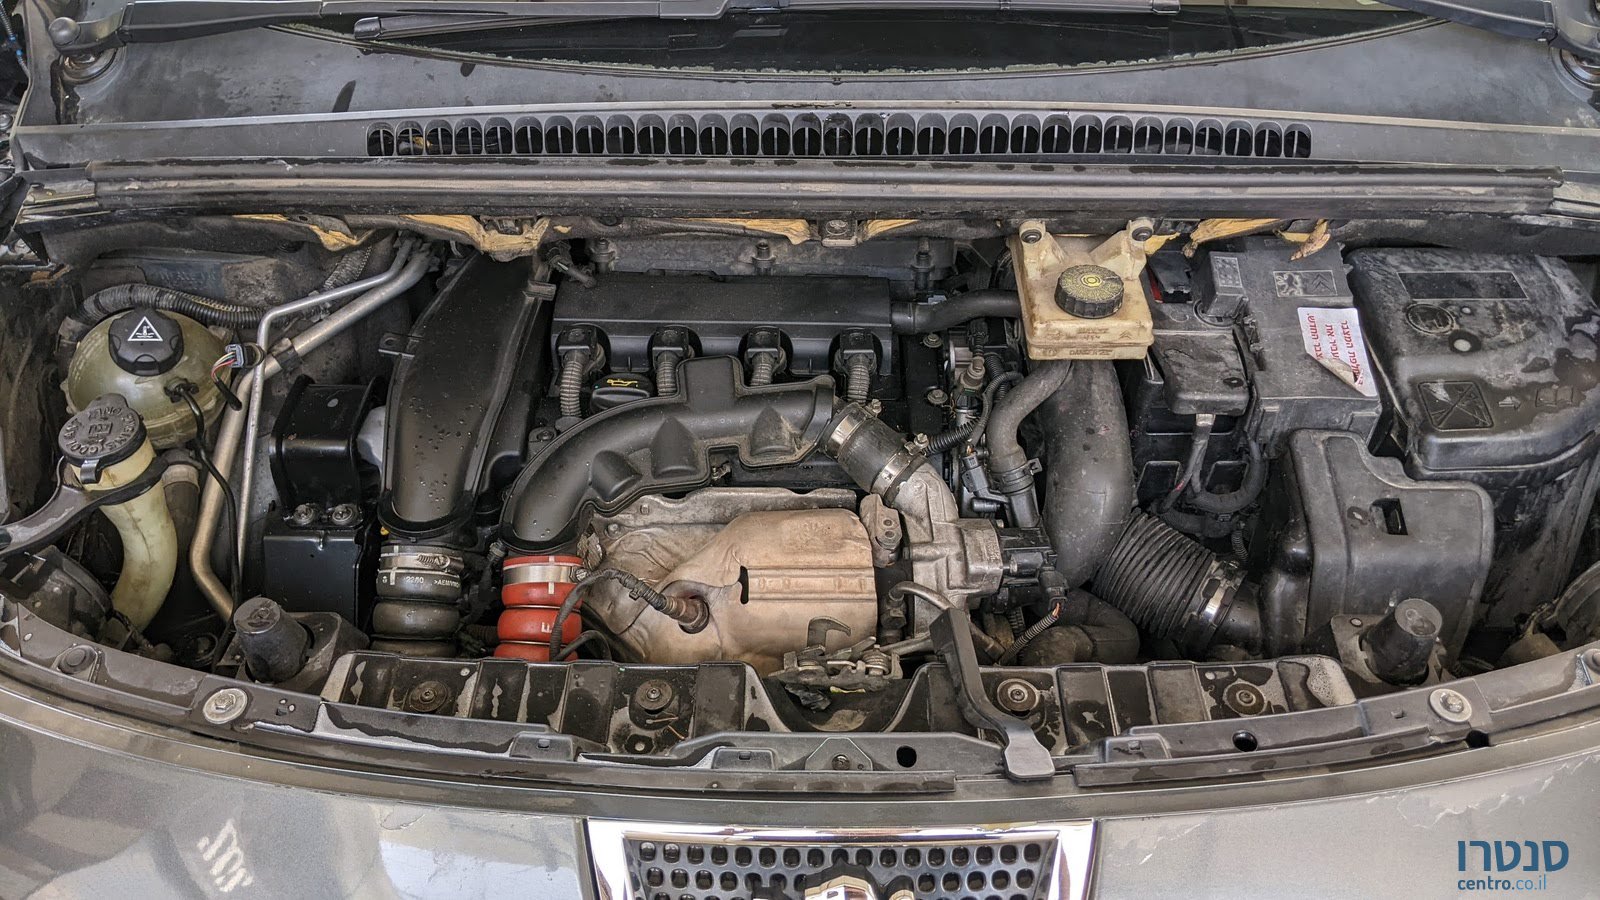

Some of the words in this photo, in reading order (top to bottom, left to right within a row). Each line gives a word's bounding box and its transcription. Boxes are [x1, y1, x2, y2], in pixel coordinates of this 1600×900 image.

[1325, 324, 1335, 337] את
[1340, 320, 1353, 348] המצבר
[1313, 343, 1323, 361] צבר
[1329, 340, 1340, 361] עביר
[63, 417, 99, 455] COOLANT
